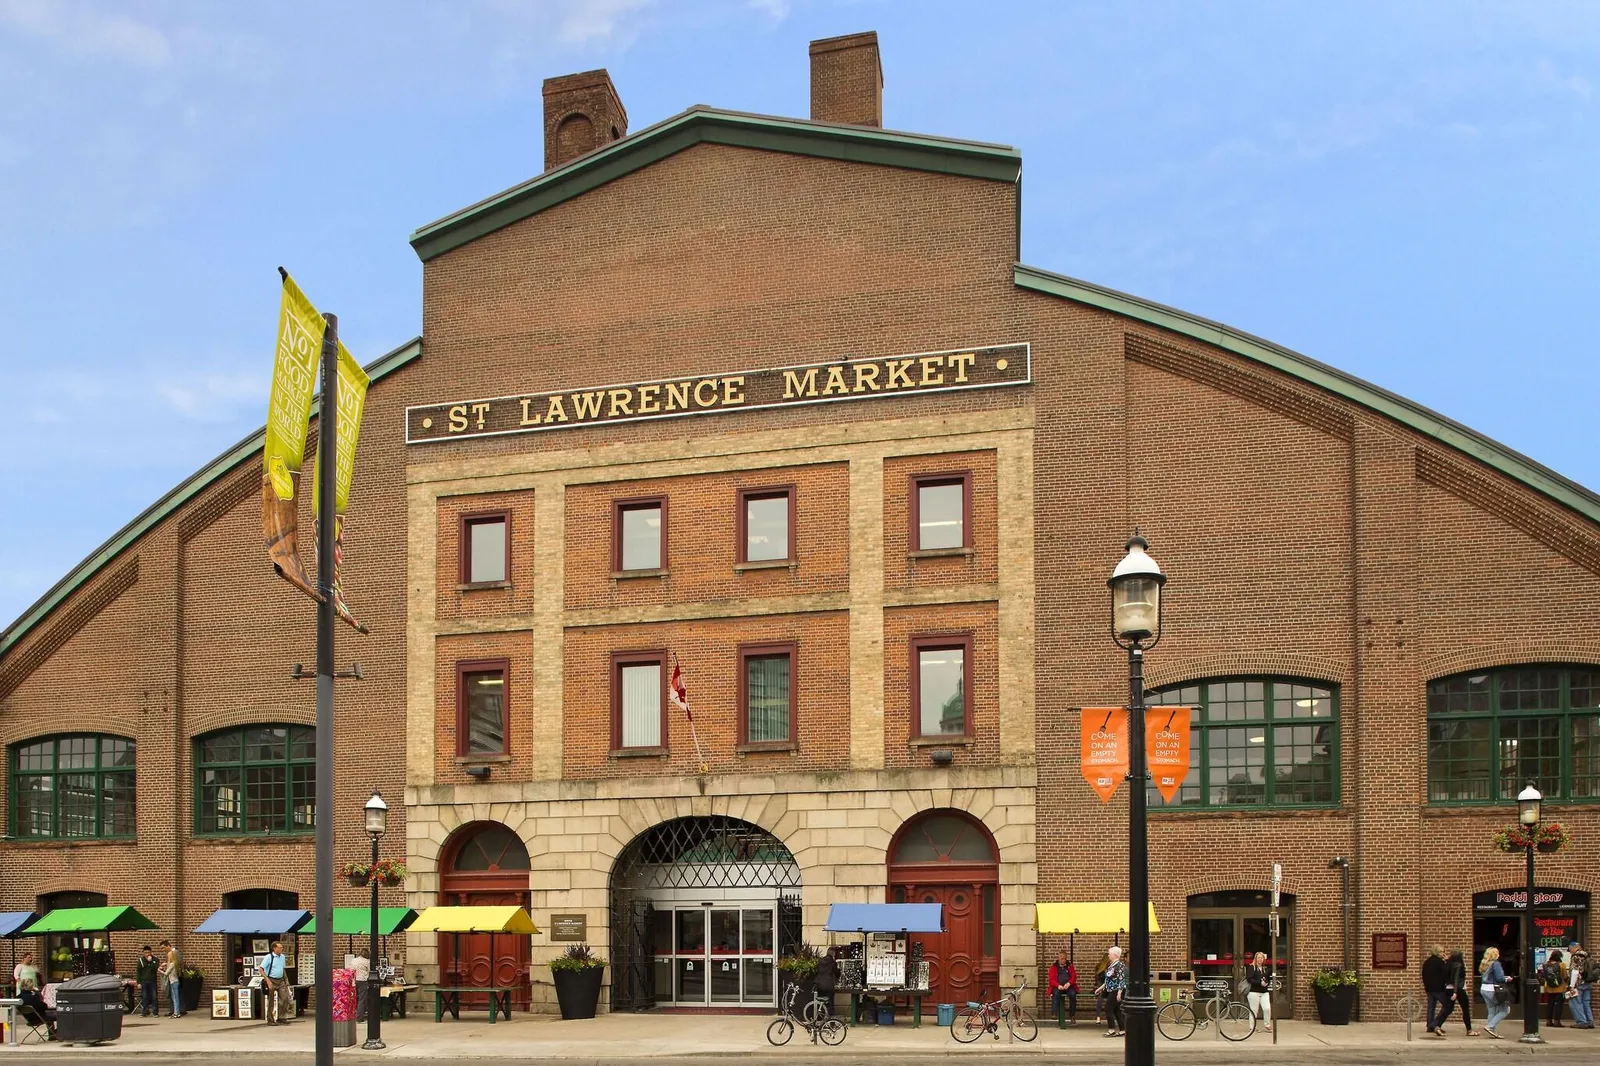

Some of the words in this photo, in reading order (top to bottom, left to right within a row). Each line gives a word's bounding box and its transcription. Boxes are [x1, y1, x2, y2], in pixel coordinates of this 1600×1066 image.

[279, 349, 309, 393] FOOD
[276, 367, 307, 407] MARKET
[519, 376, 745, 425] LAWRENCE
[782, 353, 975, 399] MARKET
[273, 404, 301, 440] WORLD
[285, 396, 304, 427] THE
[1091, 731, 1117, 740] COME
[1156, 730, 1179, 740] COME
[1497, 891, 1564, 904] Paddigton's
[1534, 917, 1574, 927] Restaurant
[1540, 937, 1563, 947] OPEN
